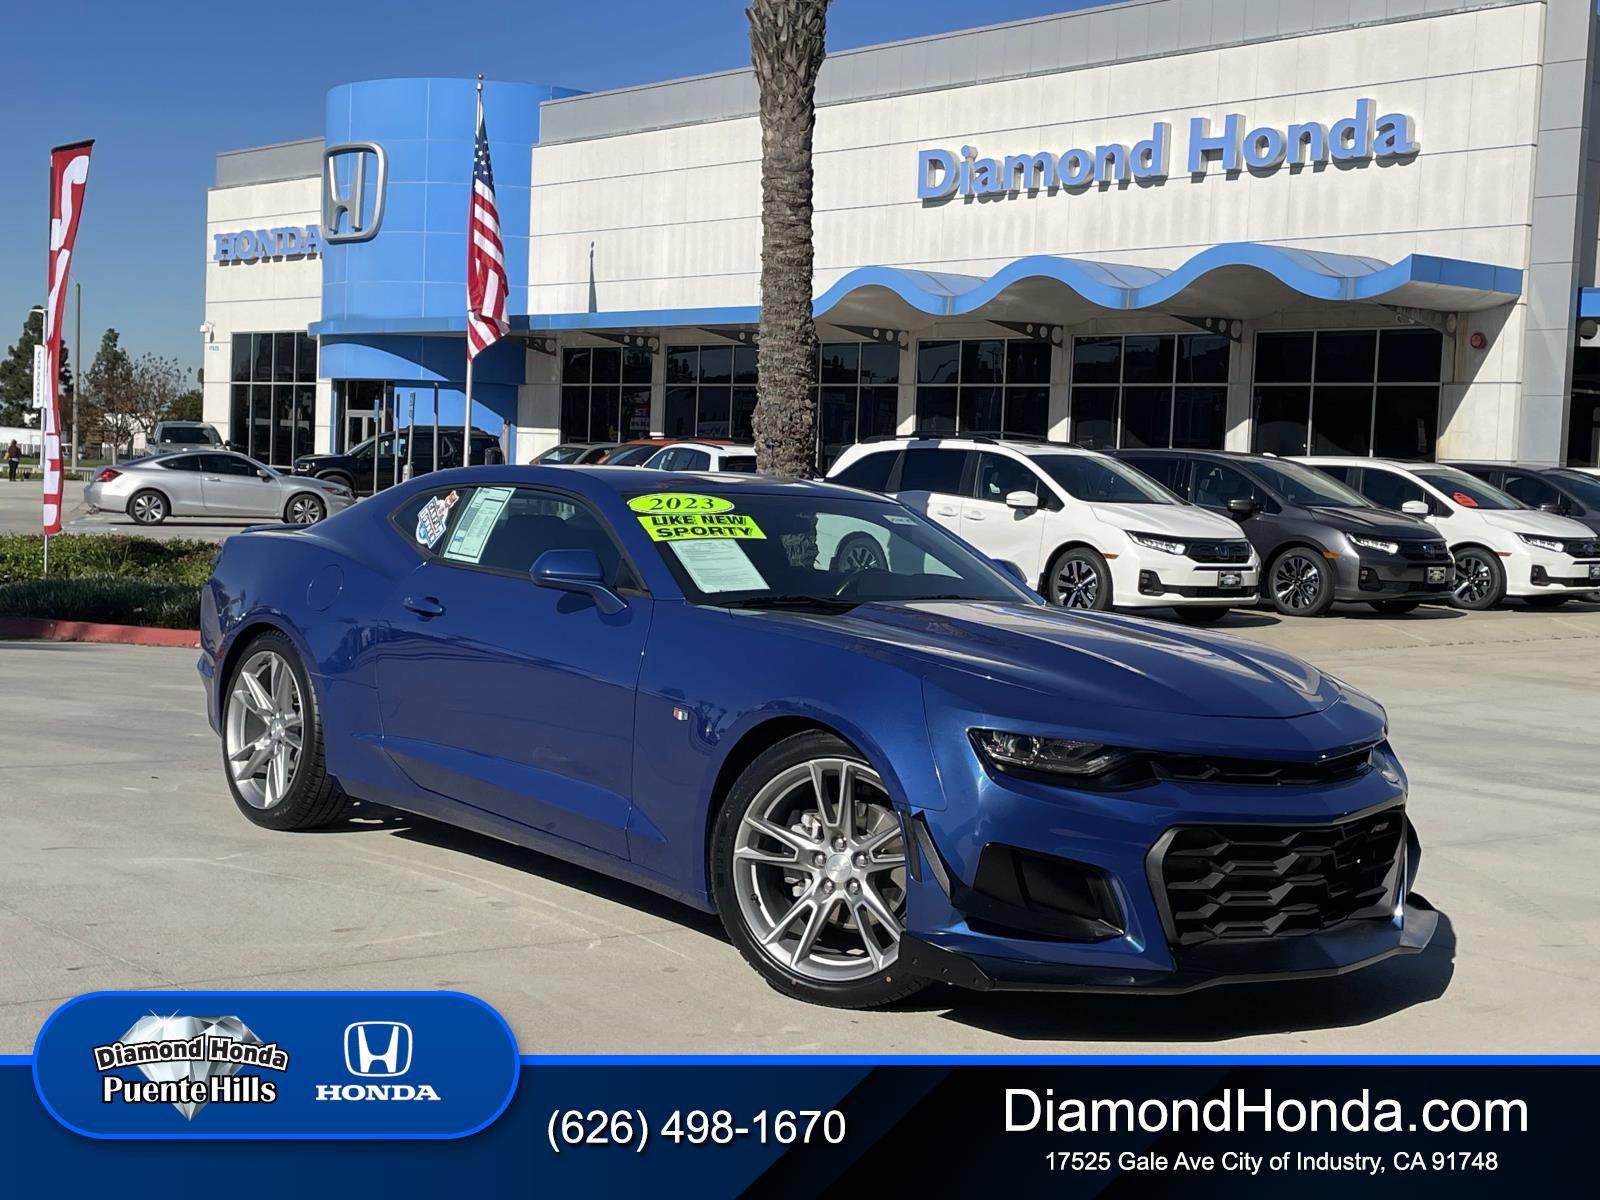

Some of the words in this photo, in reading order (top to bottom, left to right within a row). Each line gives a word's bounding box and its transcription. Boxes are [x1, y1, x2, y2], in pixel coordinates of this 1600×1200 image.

[917, 122, 1172, 201] Diamond
[1187, 98, 1420, 174] Honda
[213, 224, 322, 261] HONDA
[649, 497, 714, 511] 2023
[651, 515, 695, 526] LIKE
[702, 514, 747, 526] NEW
[656, 526, 752, 538] SPORTY
